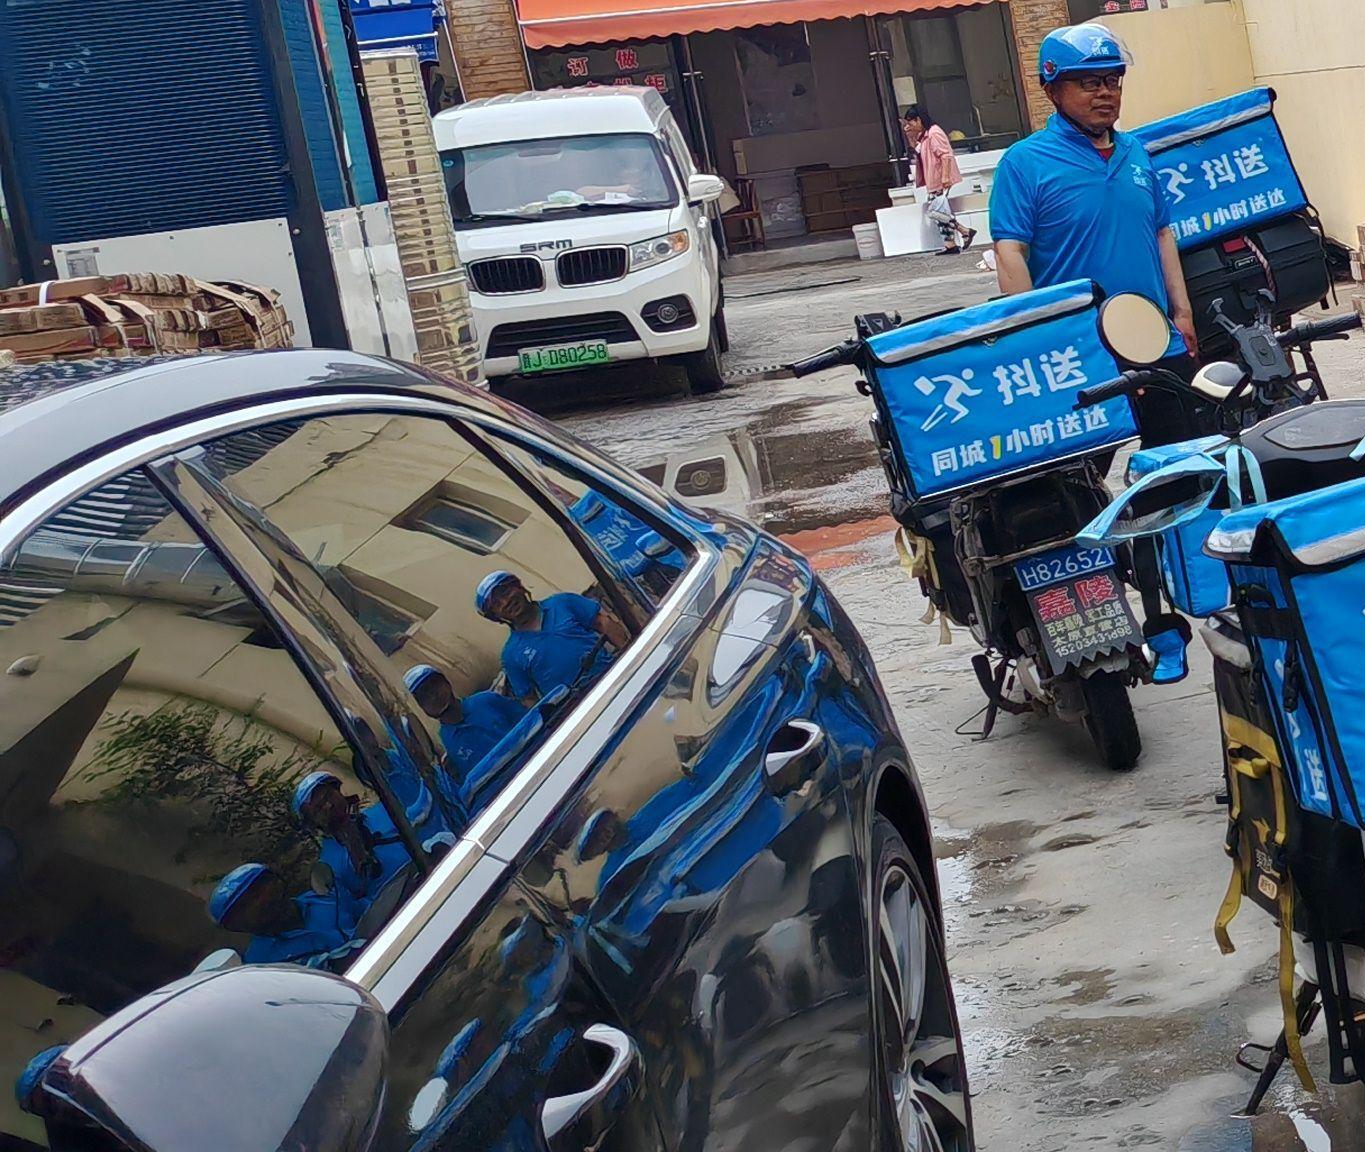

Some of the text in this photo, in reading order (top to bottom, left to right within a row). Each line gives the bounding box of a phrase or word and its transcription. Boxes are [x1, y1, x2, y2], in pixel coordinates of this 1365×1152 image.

[1201, 144, 1269, 190] 抖送
[520, 239, 573, 253] SRM
[992, 345, 1088, 405] 抖送
[931, 404, 1109, 476] 同城1小时送达
[1022, 548, 1107, 586] H82652
